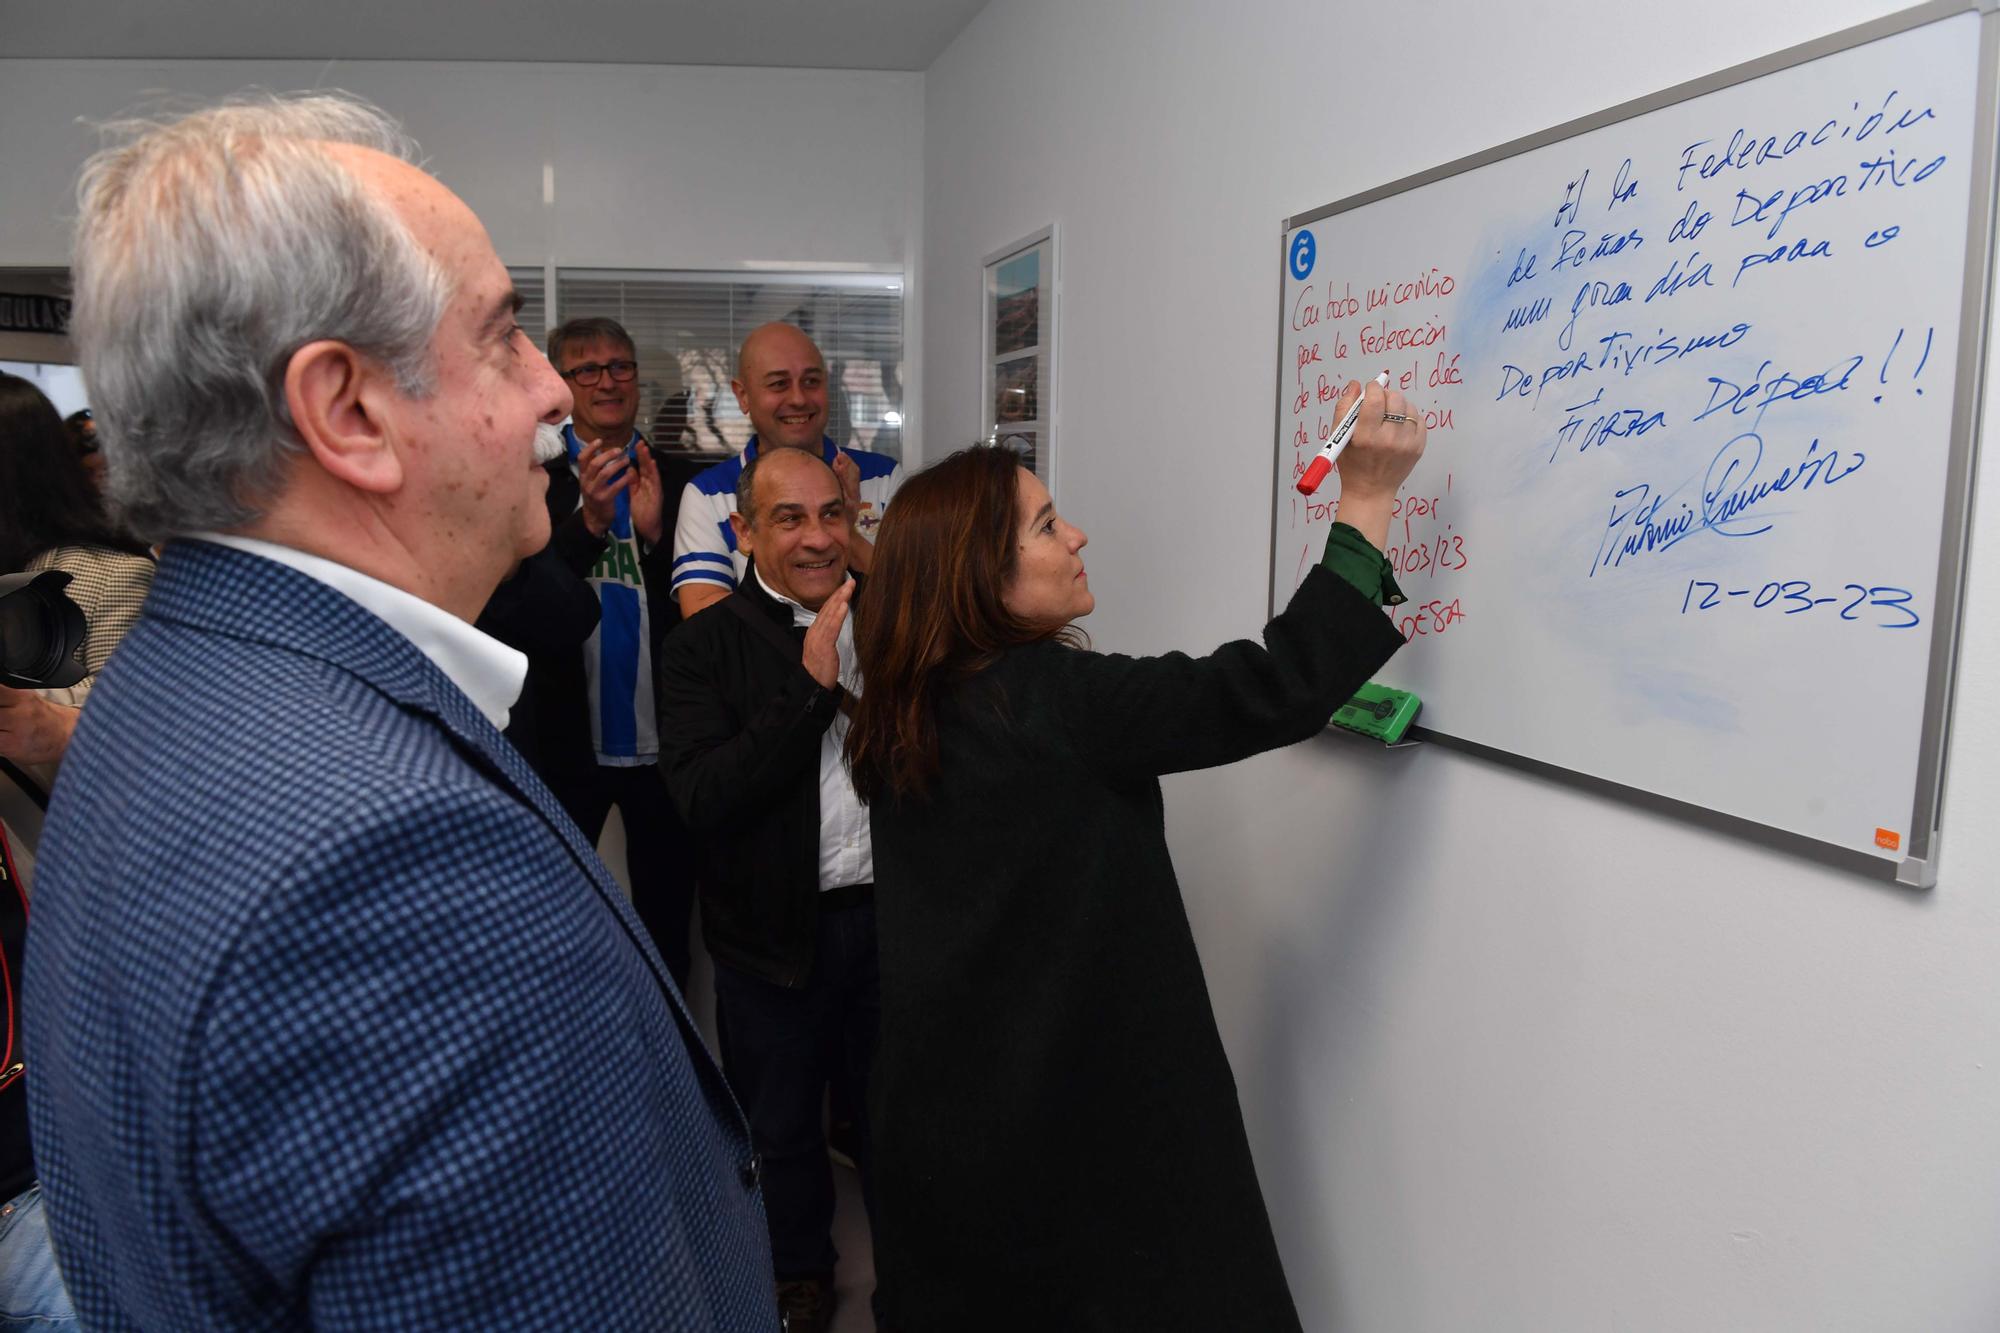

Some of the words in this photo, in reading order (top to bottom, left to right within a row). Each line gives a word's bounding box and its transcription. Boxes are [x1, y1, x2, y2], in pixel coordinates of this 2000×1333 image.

[1608, 158, 1639, 211] la
[1677, 90, 1936, 193] Federación
[1645, 251, 1714, 302] día
[1682, 579, 1919, 628] 12-03-23
